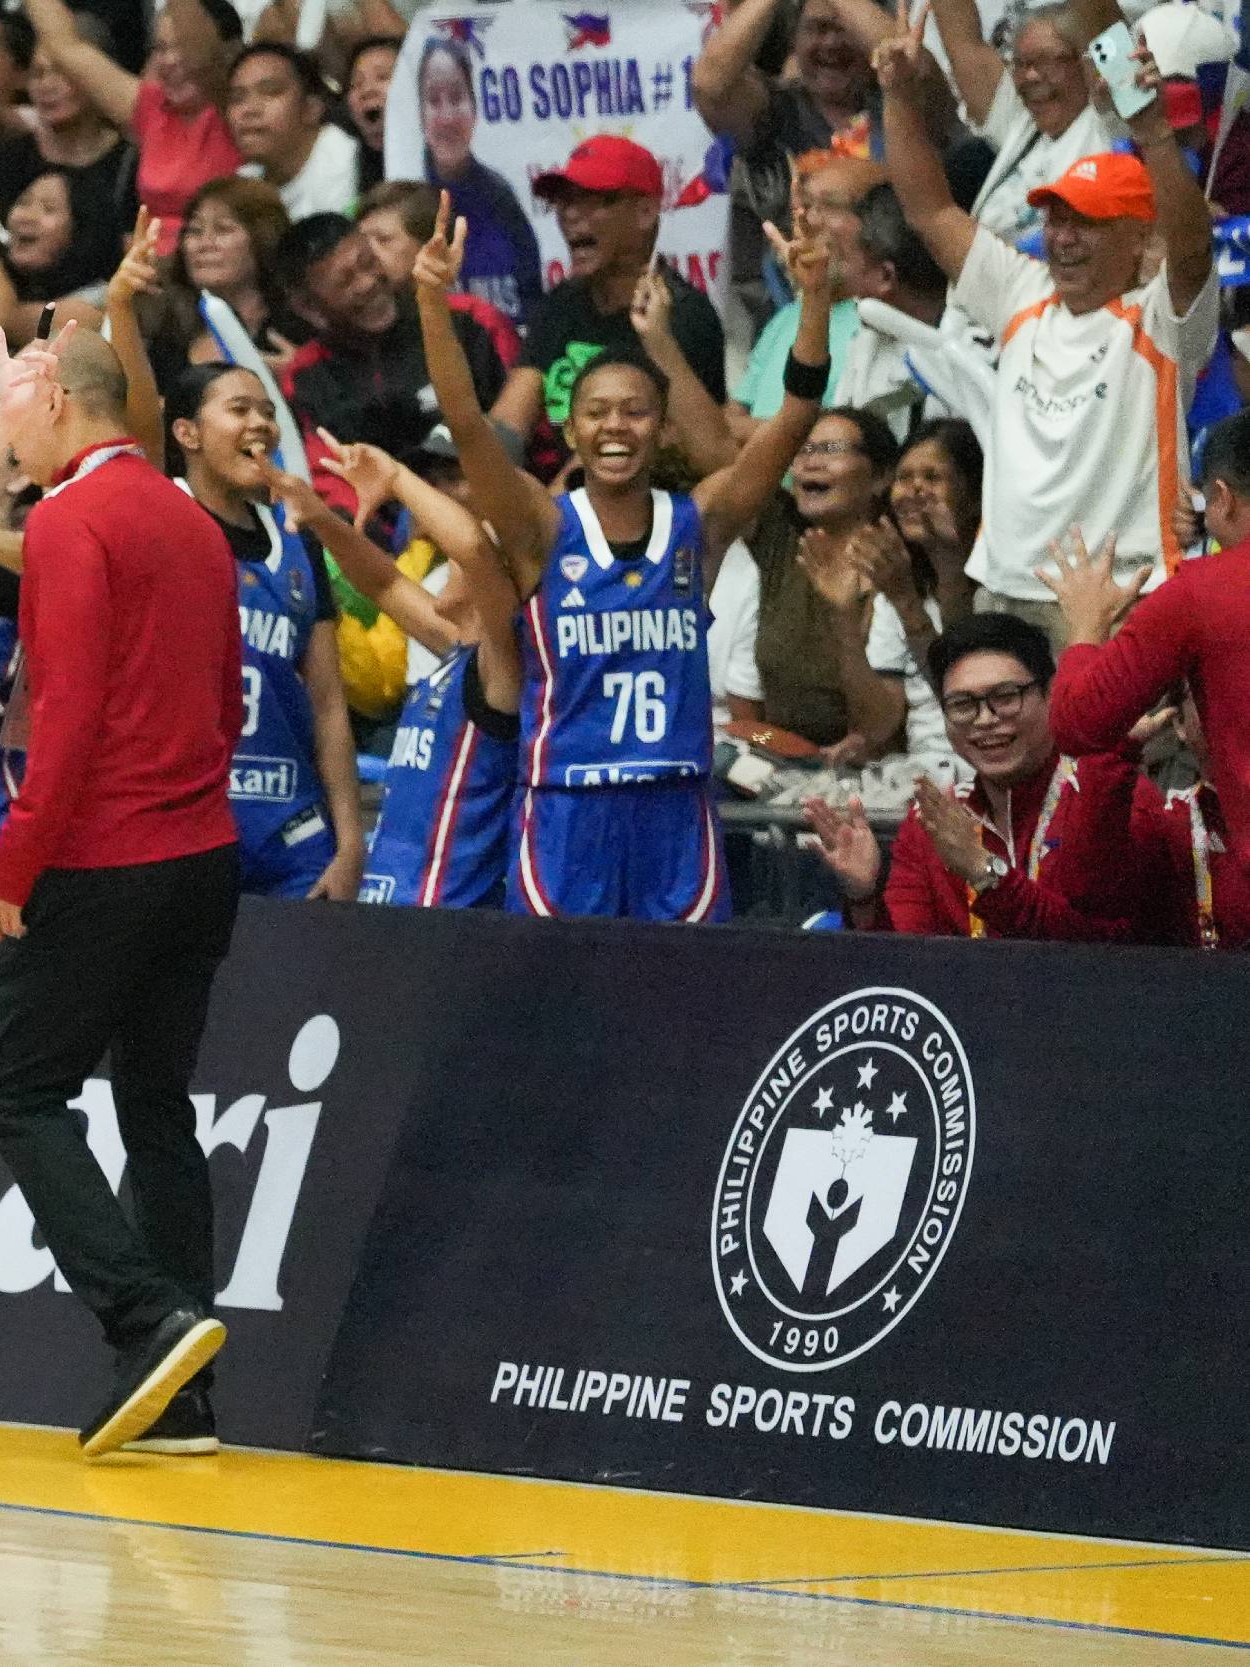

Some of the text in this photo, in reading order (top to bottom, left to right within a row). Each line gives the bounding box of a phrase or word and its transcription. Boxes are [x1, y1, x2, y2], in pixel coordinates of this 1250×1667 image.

[479, 66, 523, 123] GO
[528, 58, 645, 119] SOPHIA
[557, 608, 696, 658] PILIPINAS
[603, 671, 666, 743] 76
[720, 1004, 966, 1275] PHILIPPINE SPORTS COMMISSION
[769, 1320, 839, 1356] 1990
[490, 1362, 1117, 1465] PHILIPPINE SPORTS COMMISSION
